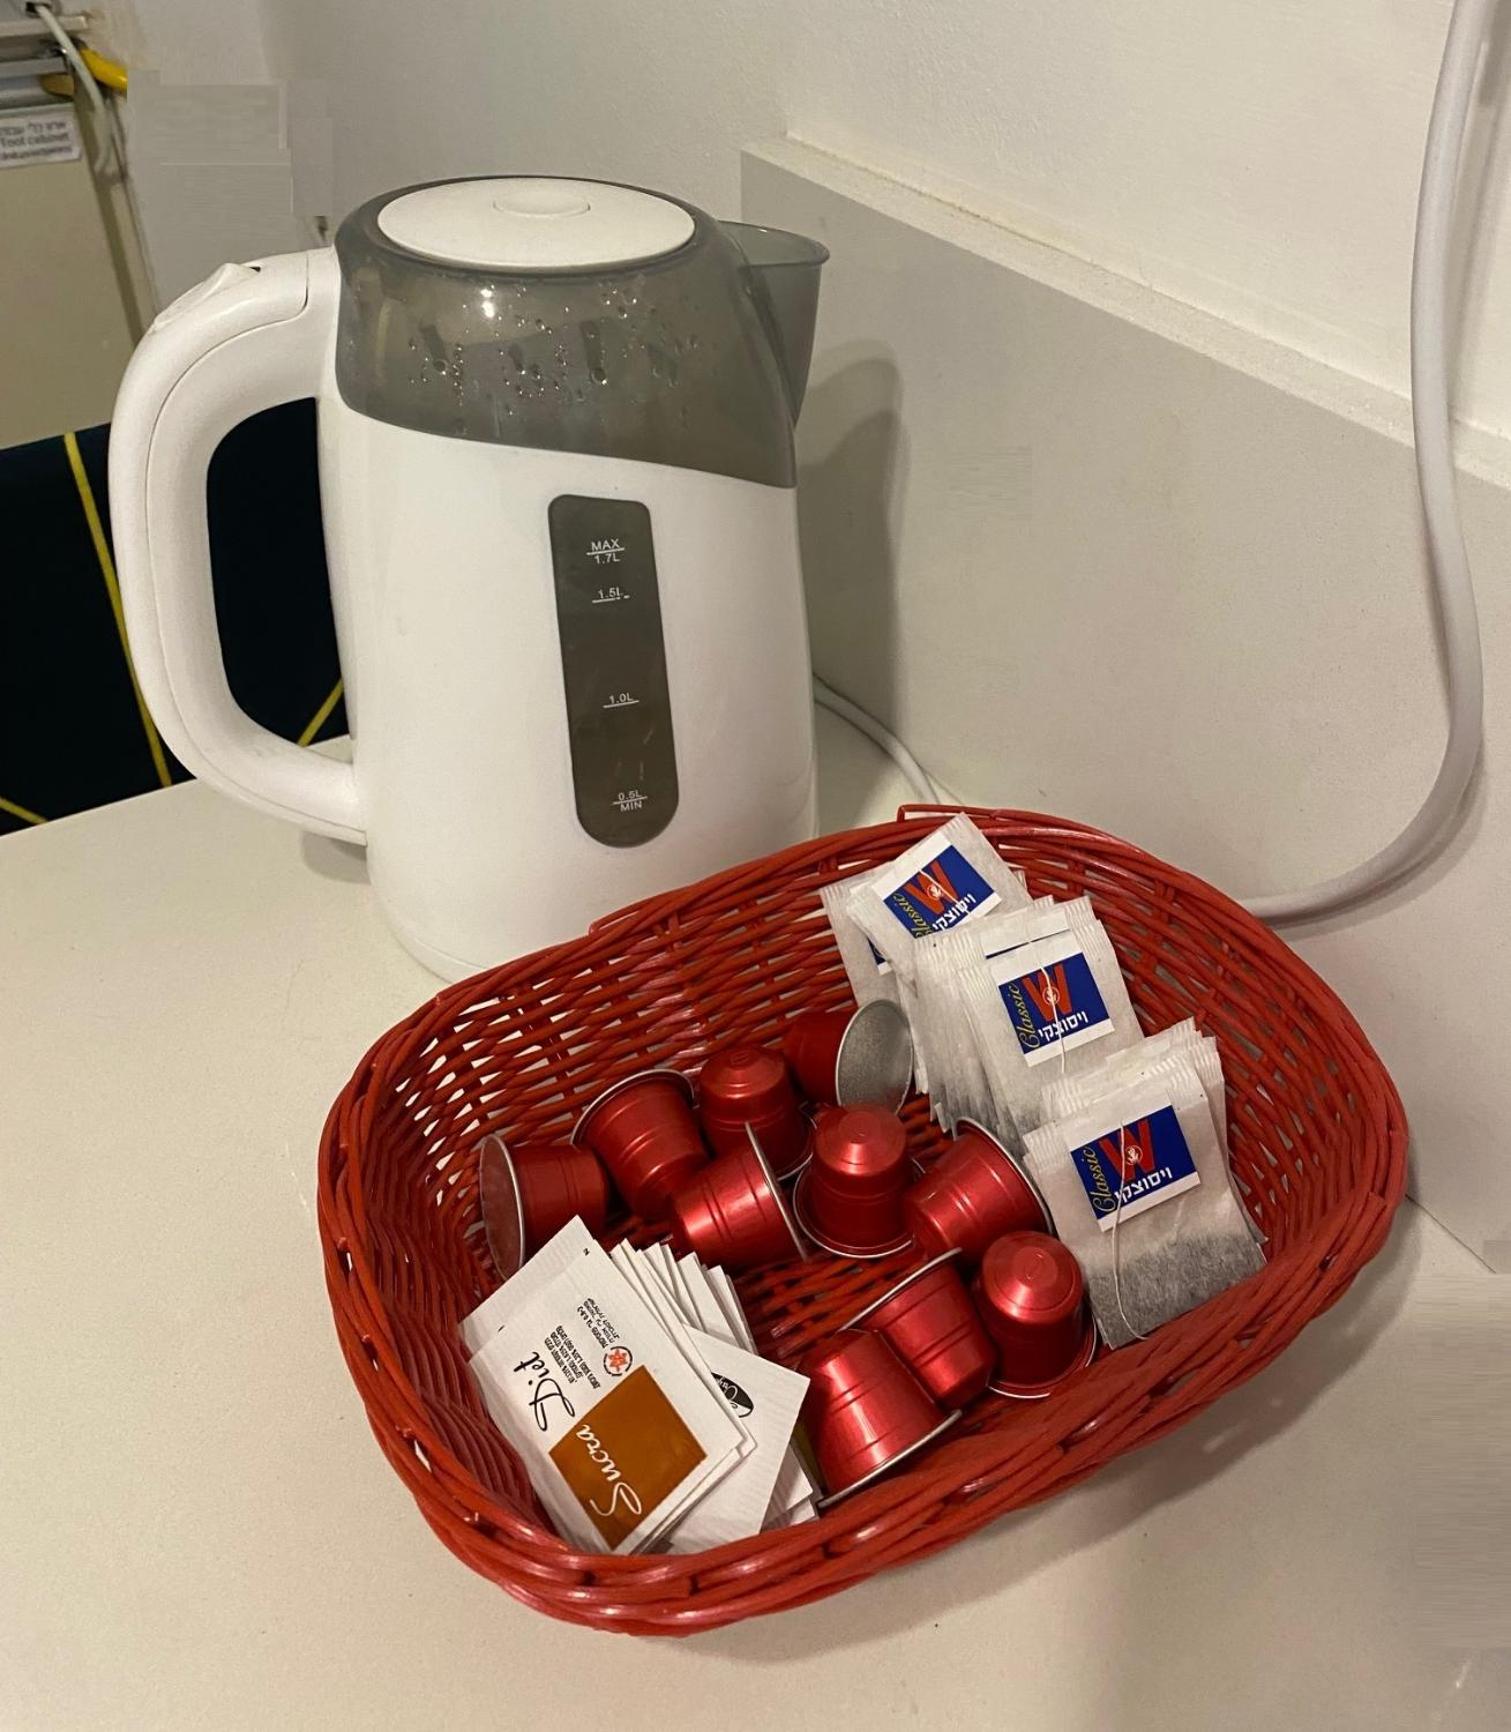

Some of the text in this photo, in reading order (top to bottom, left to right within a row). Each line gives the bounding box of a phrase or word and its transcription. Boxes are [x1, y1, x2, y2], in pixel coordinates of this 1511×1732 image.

[590, 538, 621, 551] MAX
[594, 552, 621, 564] 1.7L
[597, 586, 623, 599] 1.5L
[609, 692, 633, 704] 1.0L
[618, 790, 642, 801] 0.5L
[620, 800, 642, 812] MIN
[902, 859, 959, 915] W
[1021, 963, 1073, 1022] W
[1008, 983, 1041, 1048] Classic
[1037, 1010, 1089, 1042] ויסוצקי
[1099, 1118, 1157, 1182] W
[1080, 1146, 1116, 1212] Classic
[1113, 1166, 1173, 1203] ויסוצקי
[512, 1350, 576, 1433] Diet
[575, 1423, 643, 1517] Sucra
